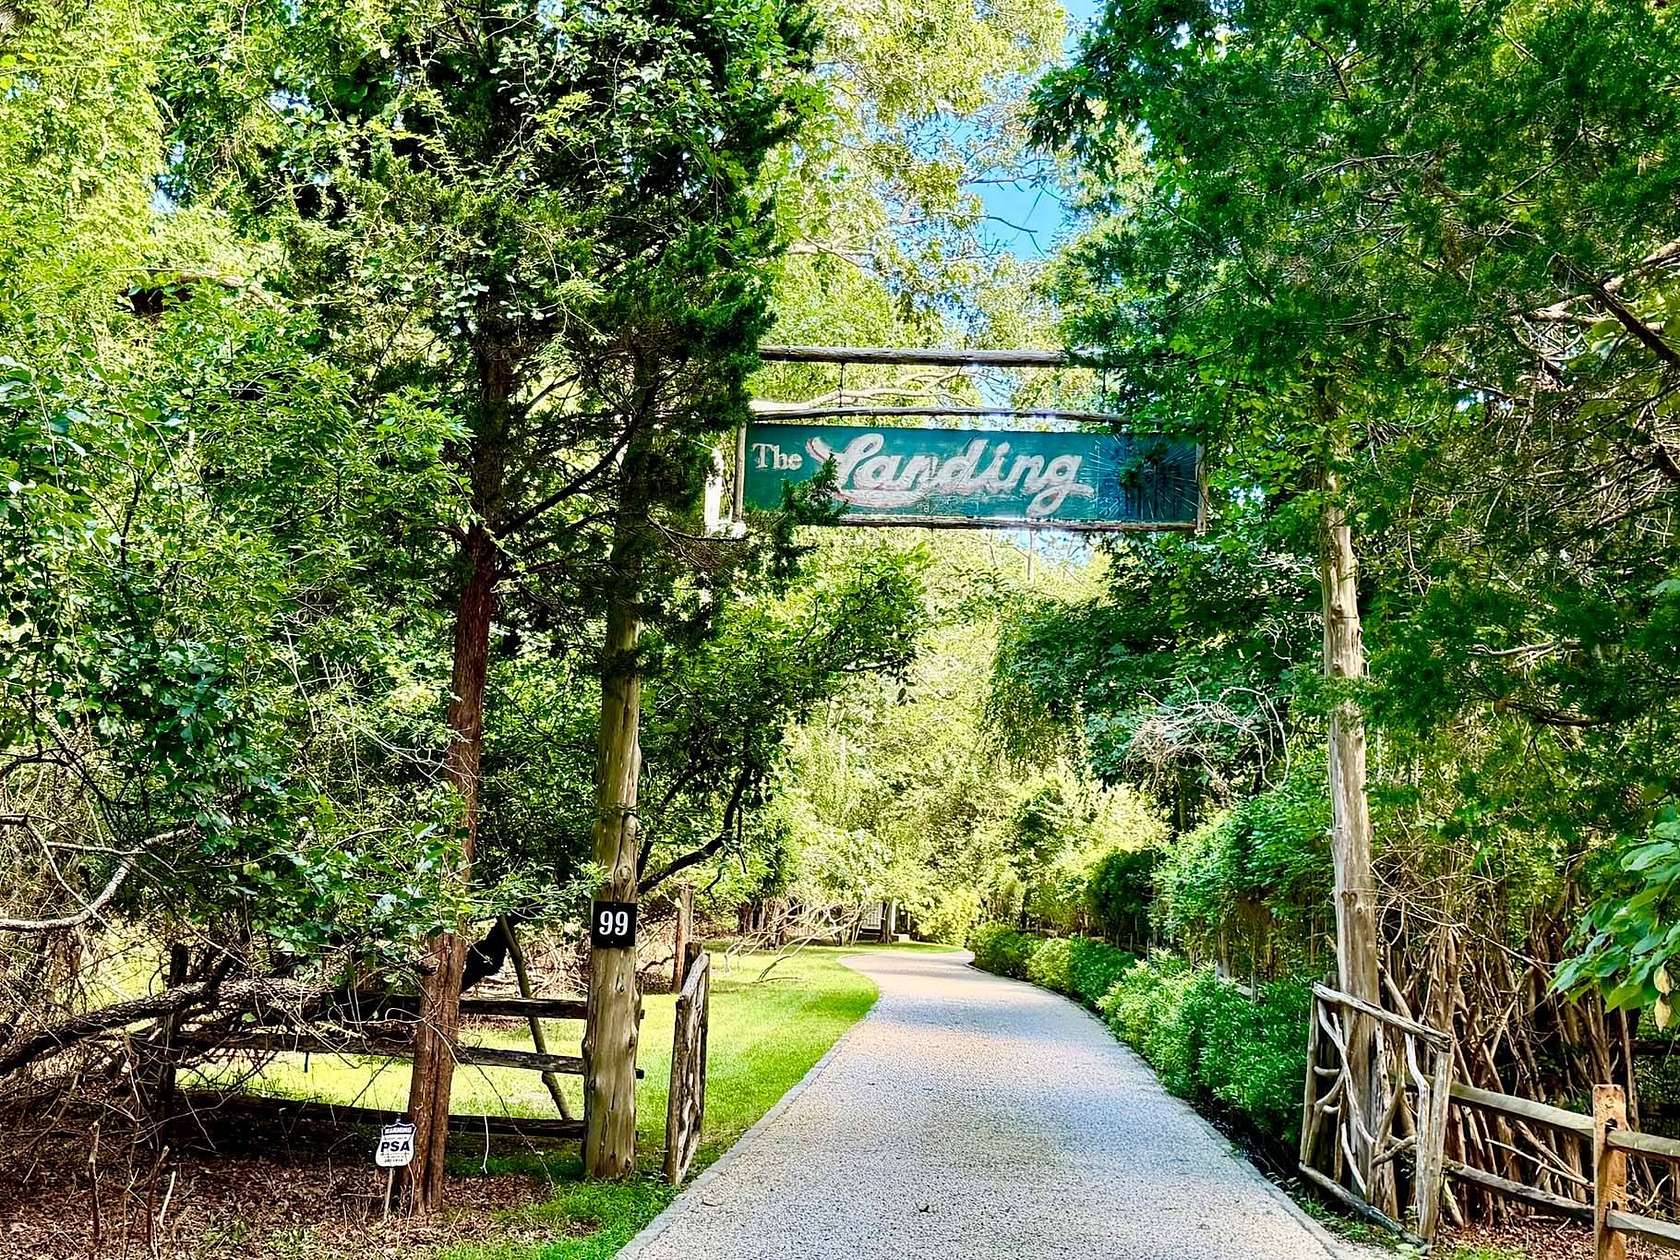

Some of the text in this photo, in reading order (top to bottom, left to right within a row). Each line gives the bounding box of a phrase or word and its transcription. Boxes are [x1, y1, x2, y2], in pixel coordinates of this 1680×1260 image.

[752, 433, 1094, 517] The Landing
[598, 910, 629, 936] 99
[380, 1141, 410, 1152] PSA
